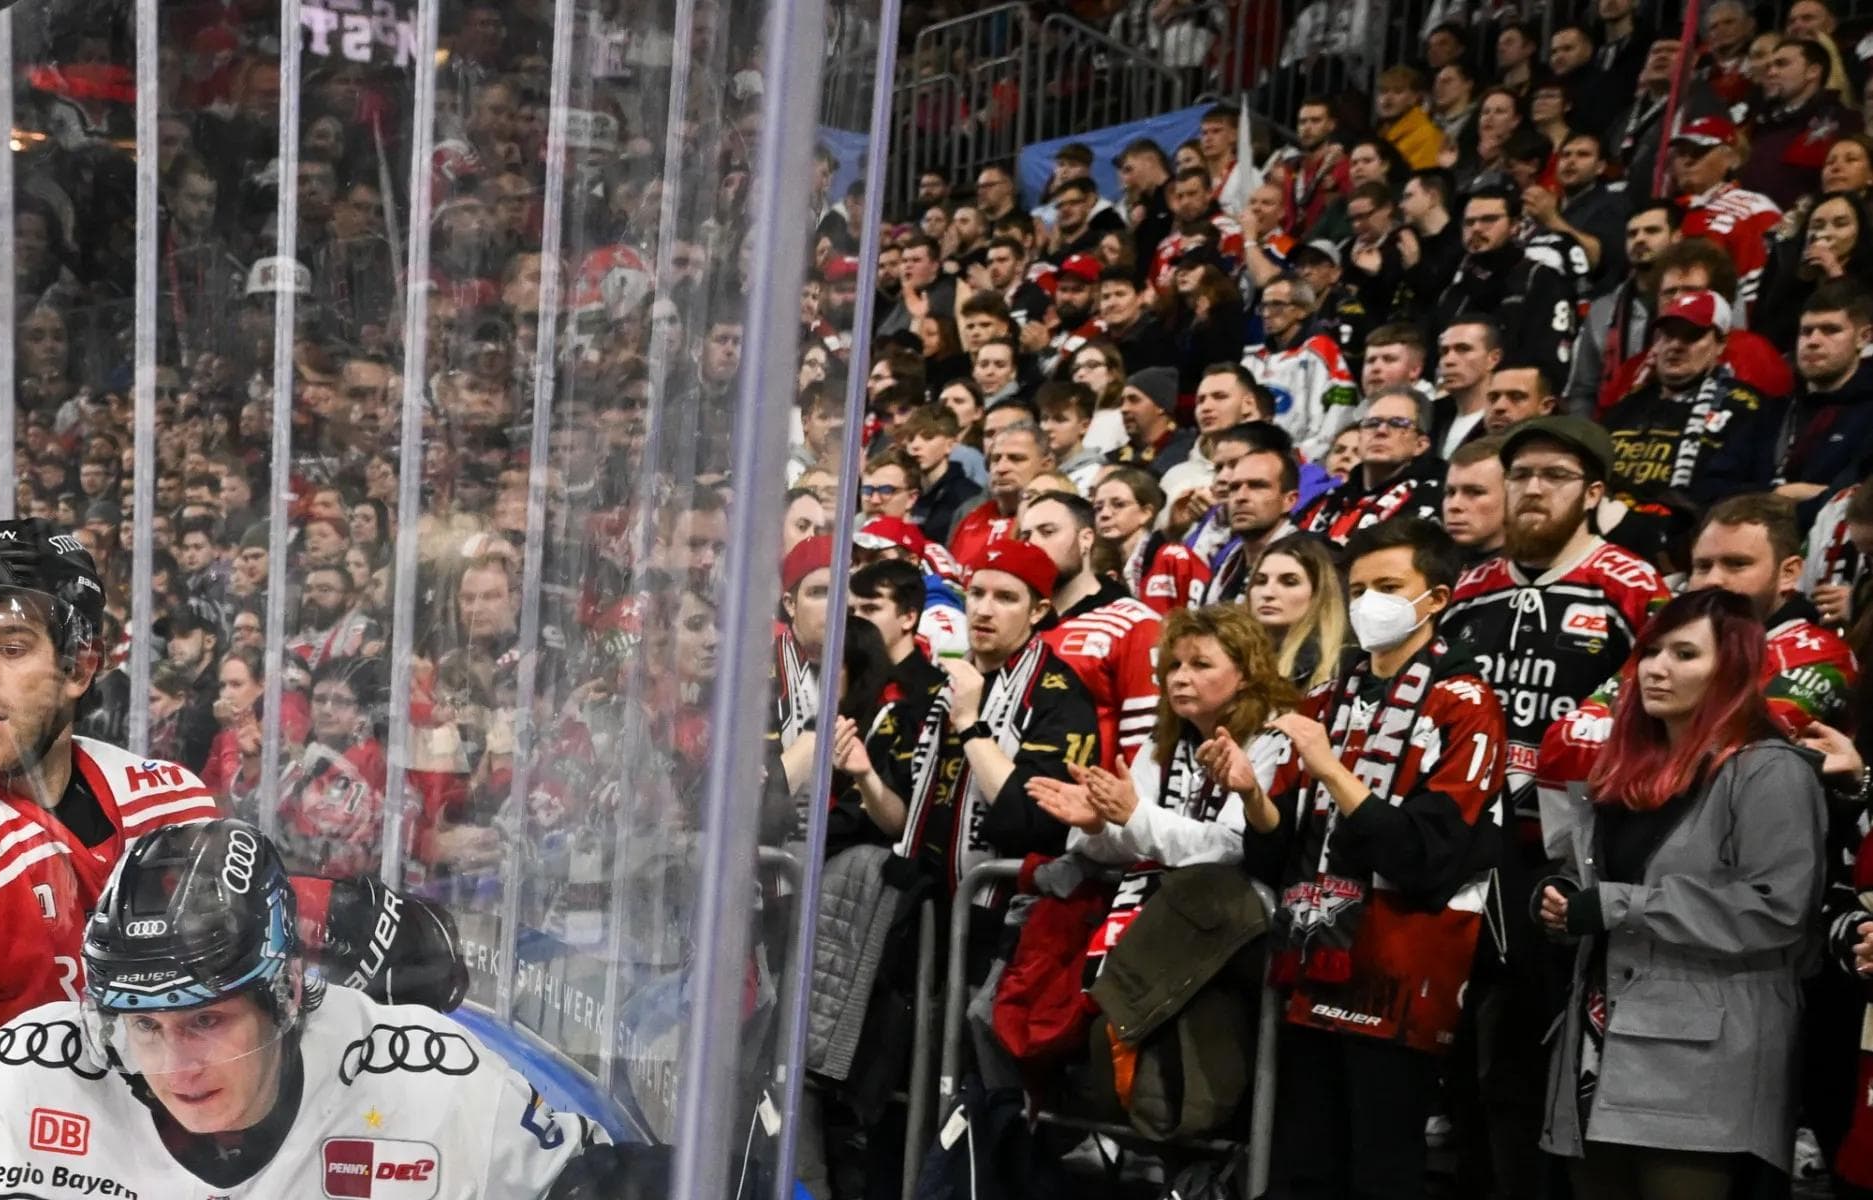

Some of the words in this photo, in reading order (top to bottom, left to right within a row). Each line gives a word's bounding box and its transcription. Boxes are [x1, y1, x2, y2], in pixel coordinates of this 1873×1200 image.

[344, 889, 404, 992] AUER
[116, 970, 178, 983] BAUER
[516, 959, 607, 1035] STAHLWERK
[1311, 1003, 1382, 1027] BAUER
[37, 1115, 81, 1148] DB
